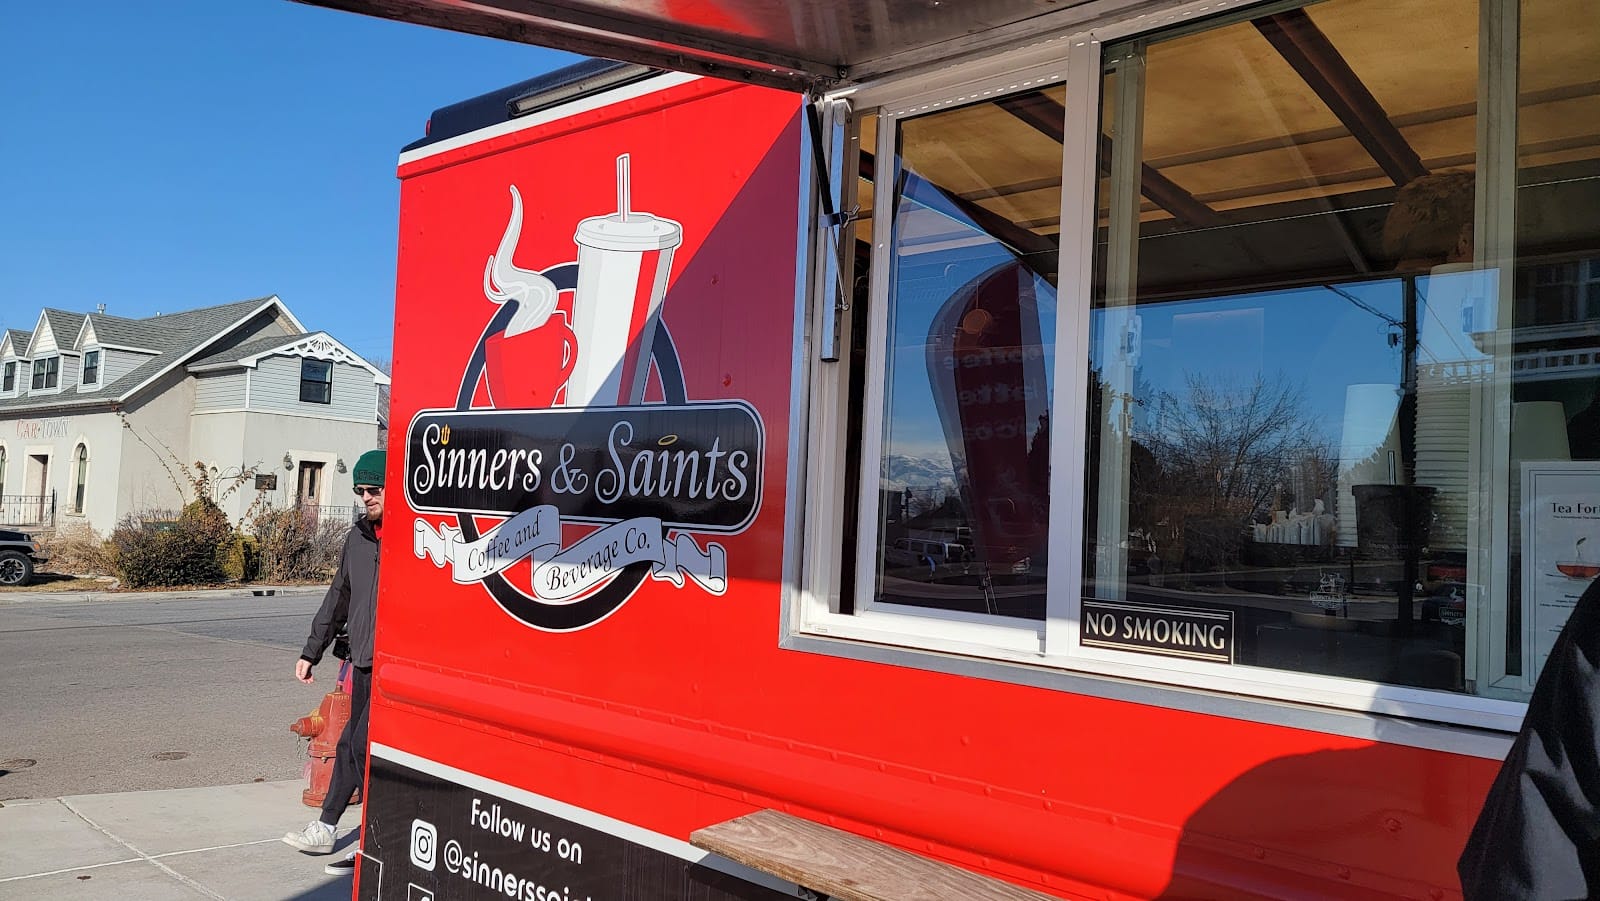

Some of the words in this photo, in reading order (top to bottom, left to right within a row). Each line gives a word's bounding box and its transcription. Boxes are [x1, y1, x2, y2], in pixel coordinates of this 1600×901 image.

[413, 423, 543, 494] Sinners
[551, 443, 589, 495] &
[595, 420, 749, 504] Saints
[1550, 502, 1572, 514] Tea
[1577, 502, 1600, 514] For
[467, 534, 511, 573] Coffee
[514, 509, 541, 546] and
[547, 538, 620, 591] Beverage
[625, 527, 650, 554] Co.
[1086, 611, 1117, 637] NO
[1122, 615, 1225, 650] SMOKING
[471, 798, 525, 842] Follow
[530, 827, 551, 852] us
[557, 837, 582, 864] on
